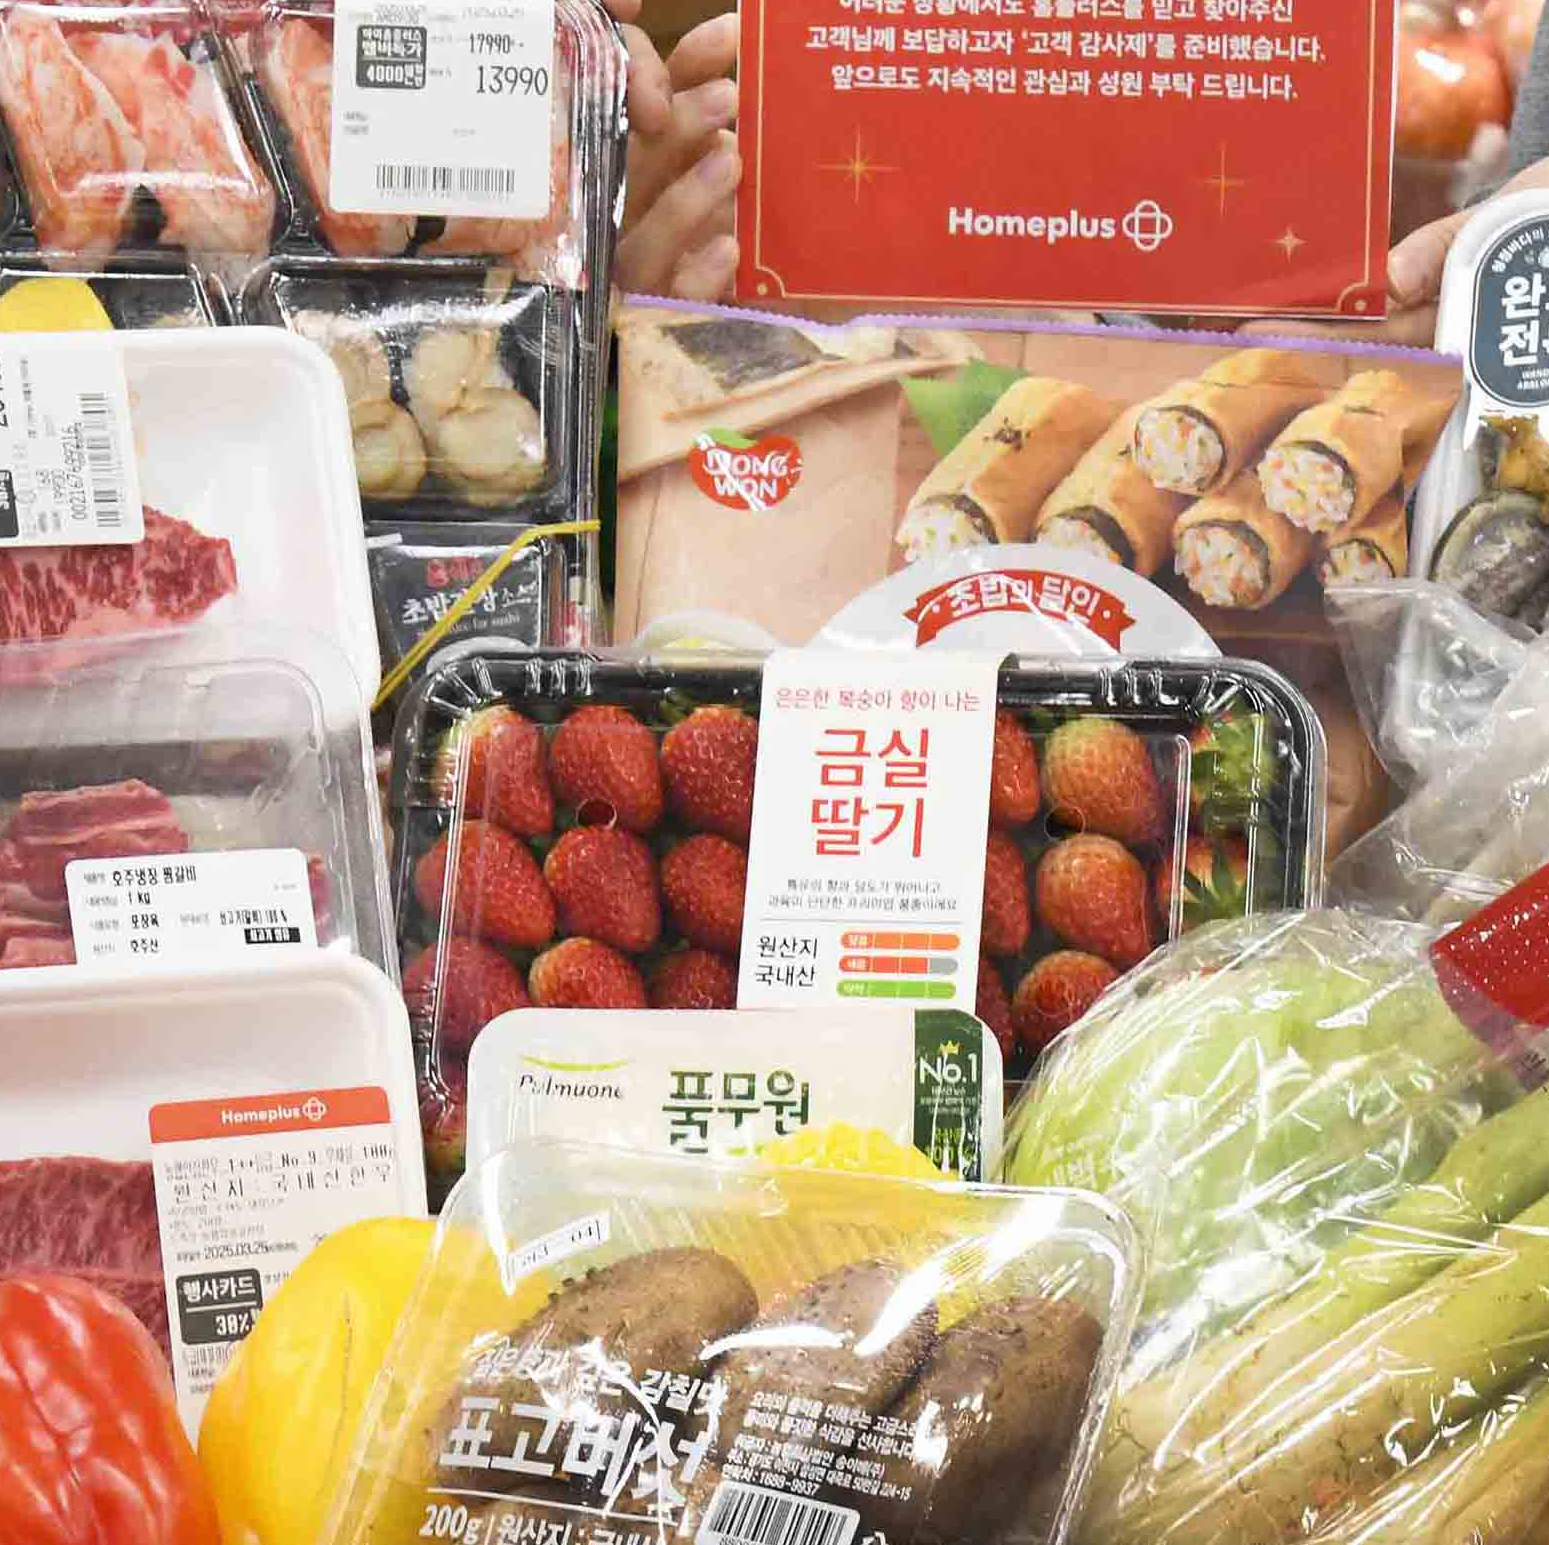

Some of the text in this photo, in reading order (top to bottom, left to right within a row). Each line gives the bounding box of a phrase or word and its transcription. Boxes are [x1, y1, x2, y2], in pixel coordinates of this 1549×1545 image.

[468, 32, 512, 55] 17990
[804, 26, 896, 54] 고객님께
[902, 27, 1015, 56] 보답하고자
[1183, 32, 1326, 63] 준비했습니다.
[476, 64, 549, 96] 13990
[831, 64, 1300, 101] 앞으로도 지속적인 관심과 성원 부탁 드립니다.
[948, 206, 1117, 246] Homeplus
[706, 449, 789, 478] DONG
[714, 475, 778, 499] WON
[775, 688, 981, 713] 은은한 복숭아 향이 나는
[814, 727, 930, 789] 금실
[810, 796, 925, 857] 딸기
[756, 935, 818, 960] 원산지
[754, 963, 816, 988] 국내산
[918, 1052, 978, 1085] No.1
[220, 1104, 303, 1125] Homeplus
[661, 1068, 811, 1155] 풀무원
[181, 1275, 257, 1304] 행사카드
[438, 1395, 712, 1509] 표고버섯
[418, 1503, 485, 1545] 200g
